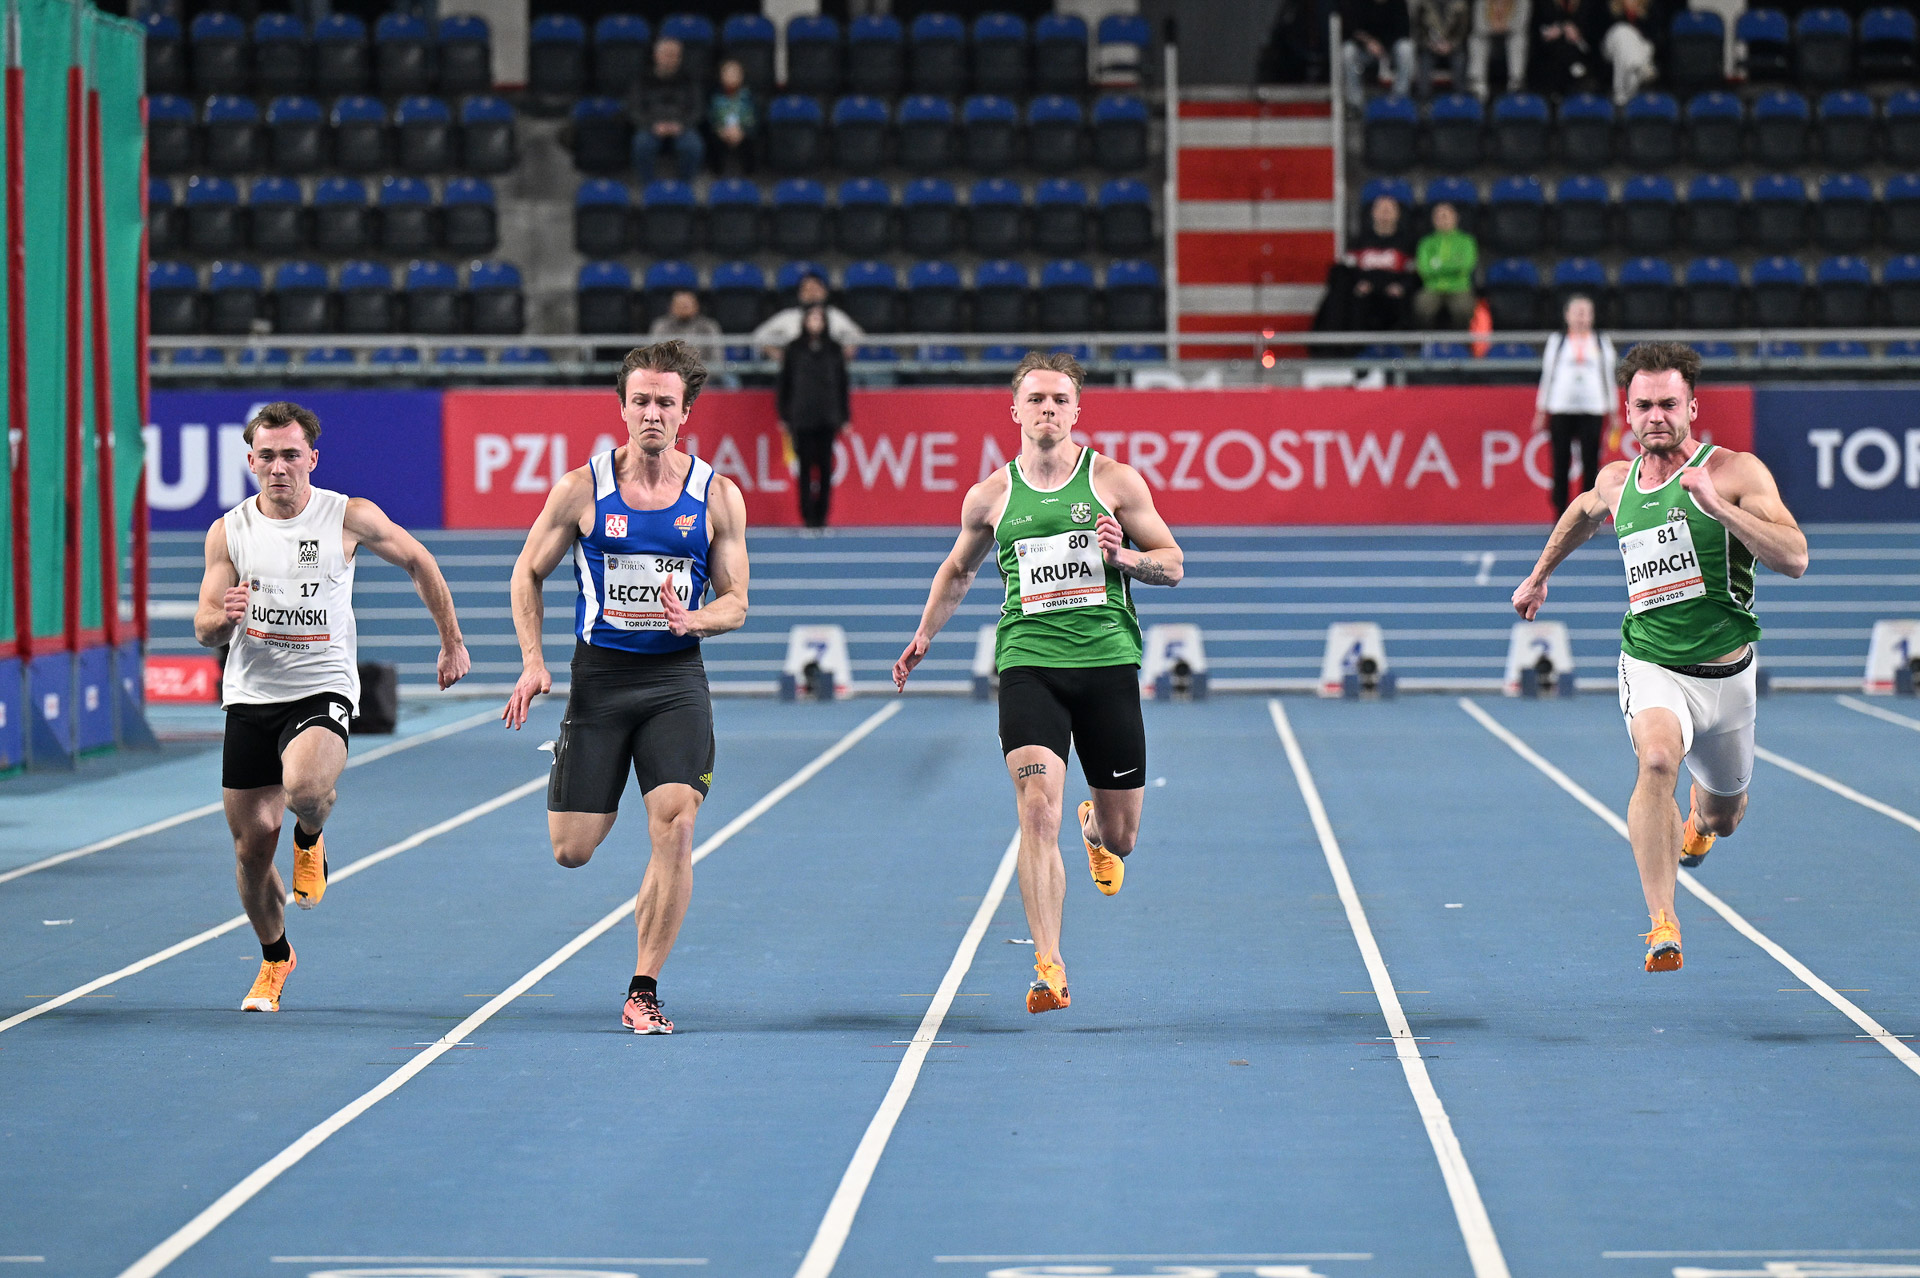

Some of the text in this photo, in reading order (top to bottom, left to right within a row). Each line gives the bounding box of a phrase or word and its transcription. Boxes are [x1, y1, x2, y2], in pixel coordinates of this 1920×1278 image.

[1068, 534, 1089, 549] 80
[1657, 526, 1678, 544] 81
[654, 558, 685, 573] 364
[1030, 561, 1092, 584] KRUPA
[1627, 551, 1696, 586] LEMPACH
[300, 582, 320, 598] 17
[608, 584, 689, 605] ŁĘCZYKI
[1665, 590, 1685, 601] 2025
[1042, 597, 1088, 608] TORUŃ 2025
[251, 604, 327, 626] ŁUCZYŃSKI
[625, 619, 652, 627] TORUŃ
[264, 640, 290, 649] TORUŃ
[1017, 763, 1046, 780] 2002
